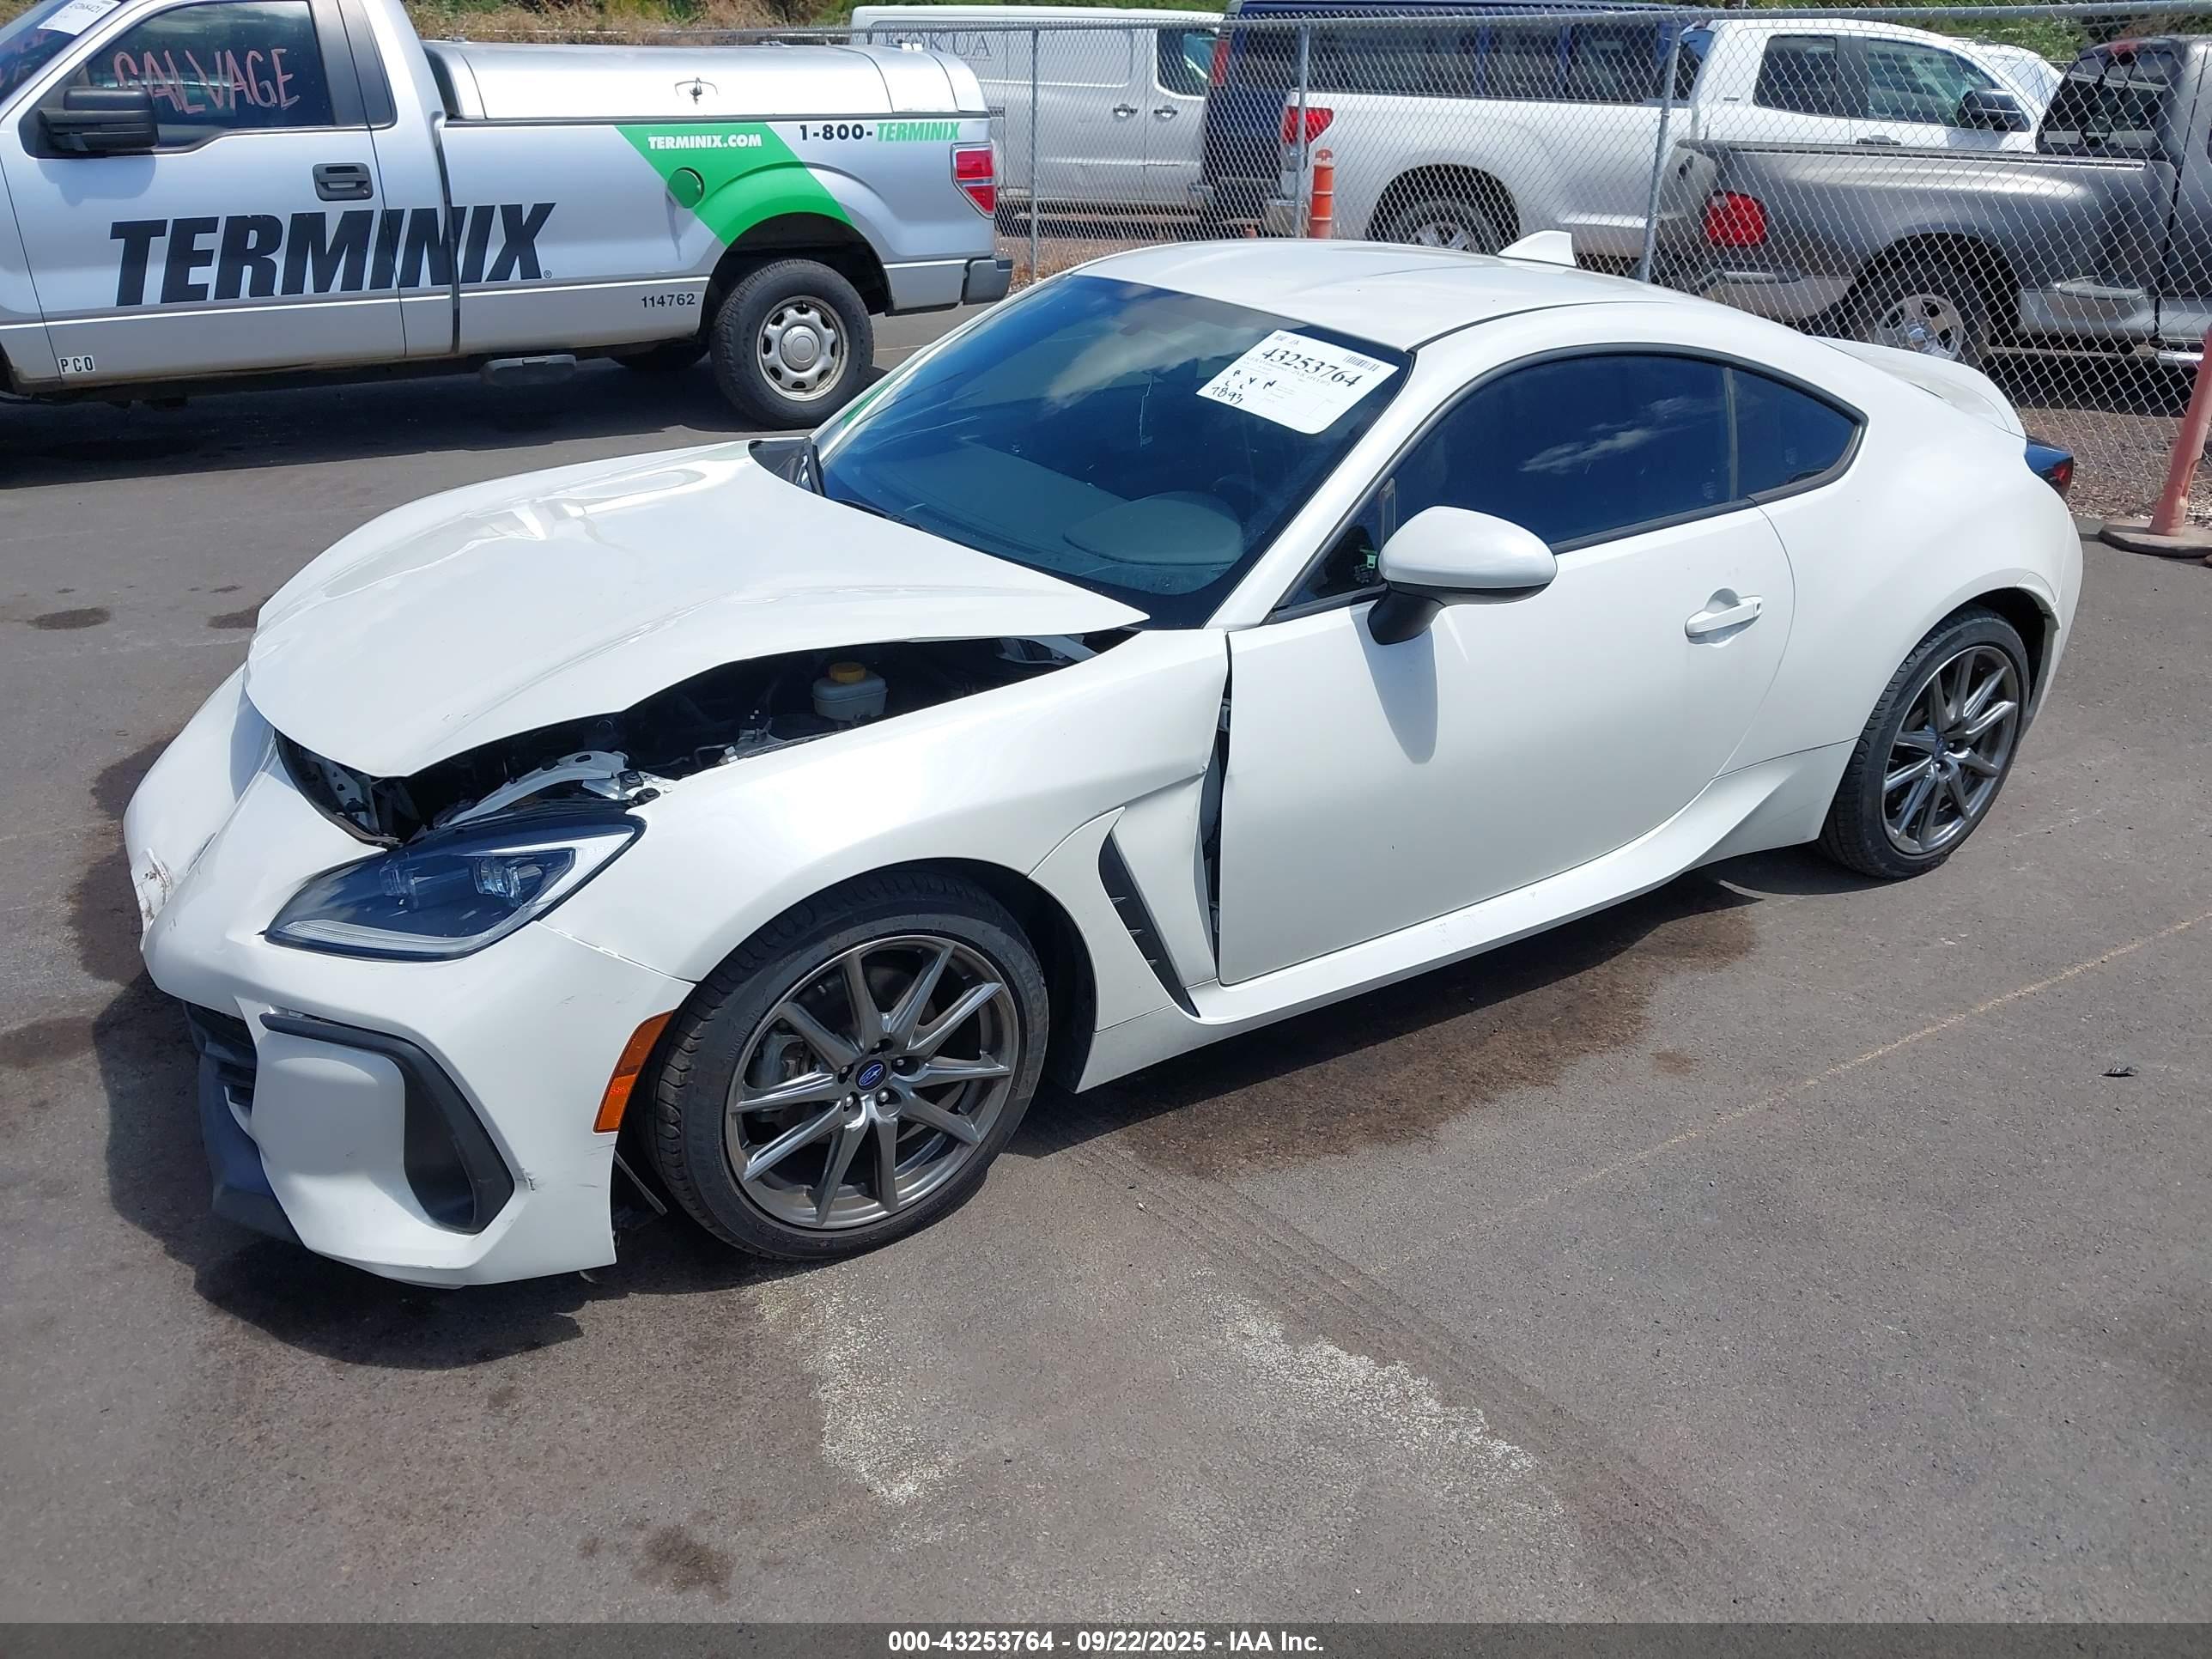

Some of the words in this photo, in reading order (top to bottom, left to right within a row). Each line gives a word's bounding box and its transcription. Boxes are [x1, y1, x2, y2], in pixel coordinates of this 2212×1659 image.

[113, 48, 300, 114] SALVAGE
[648, 133, 763, 149] TERMINIX.COM
[799, 122, 961, 143] 1-800-TERMINIX
[109, 202, 556, 307] TERMINIX
[641, 294, 696, 307] 114762
[1261, 348, 1364, 387] 43253764
